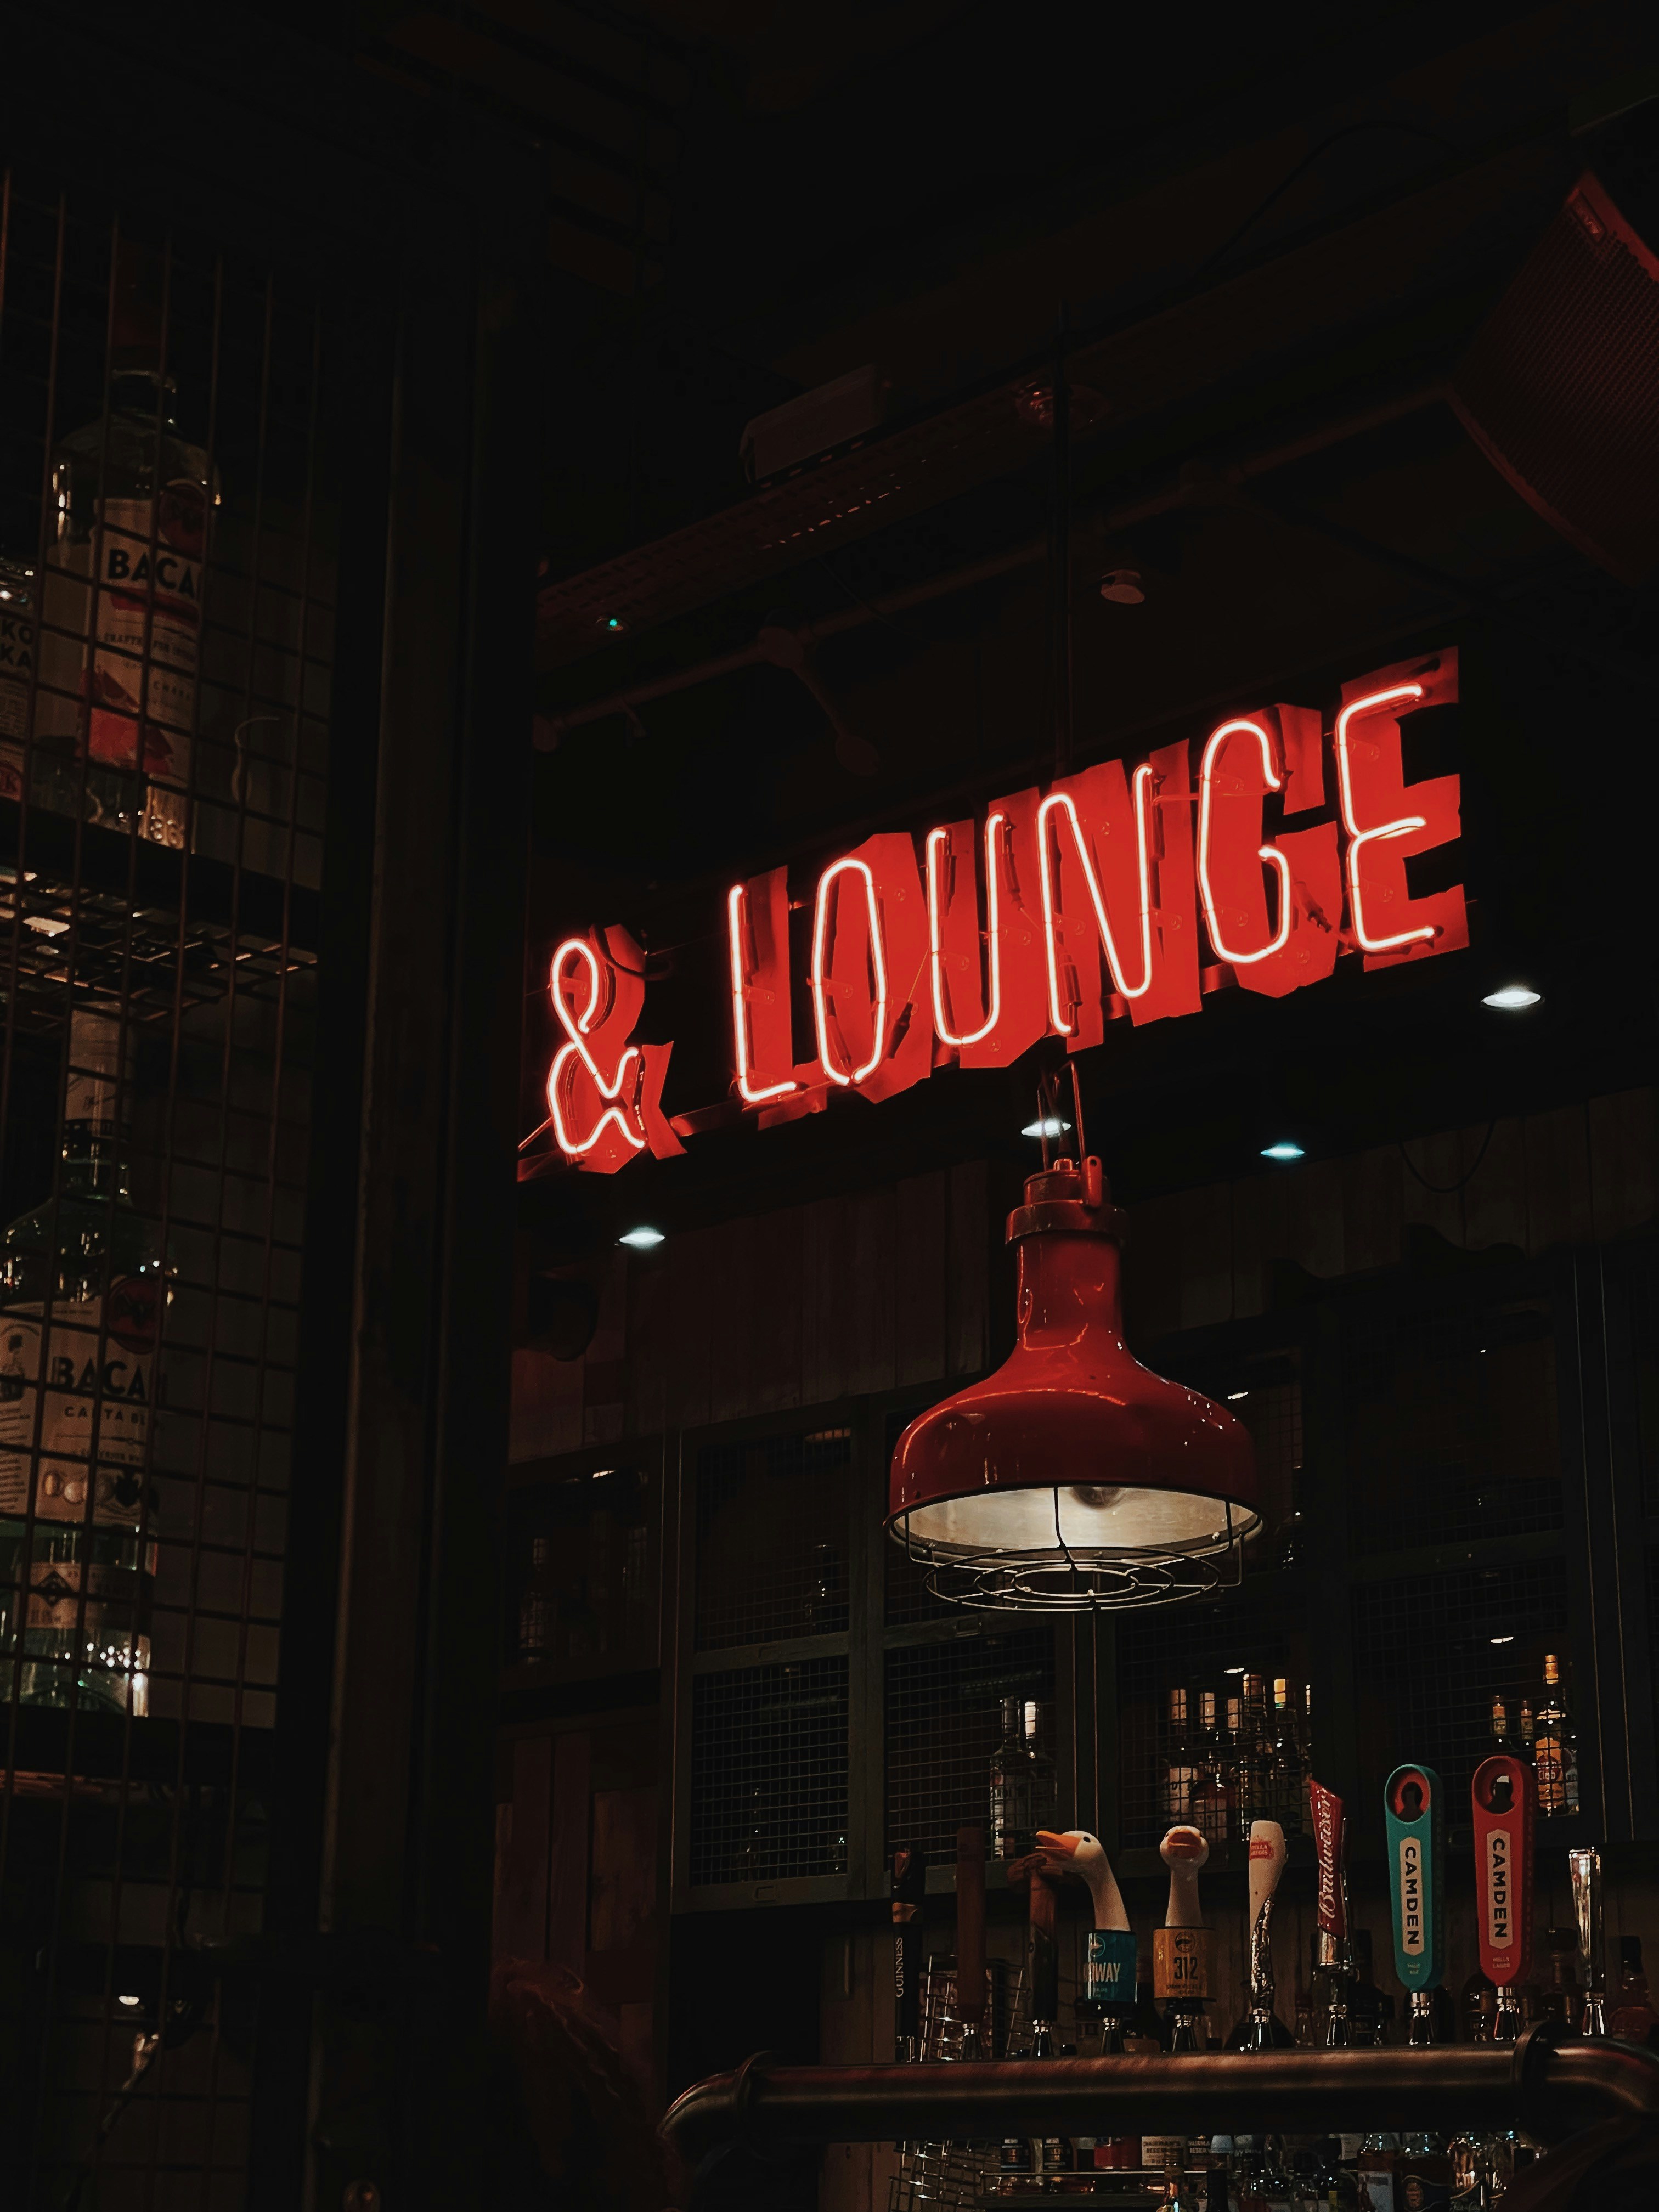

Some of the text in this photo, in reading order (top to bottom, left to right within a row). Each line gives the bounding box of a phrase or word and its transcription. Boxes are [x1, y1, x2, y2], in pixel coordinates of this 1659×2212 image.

[109, 550, 199, 600] BACA
[549, 653, 1465, 1163] & LOUNGE
[52, 1356, 147, 1399] BACA
[1318, 1793, 1336, 1919] Budweiser
[1493, 1838, 1508, 1938] CAMDEN
[1405, 1847, 1419, 1944] CAMDEN
[895, 1937, 904, 1997] GUINNESS
[1174, 1957, 1198, 1980] 312
